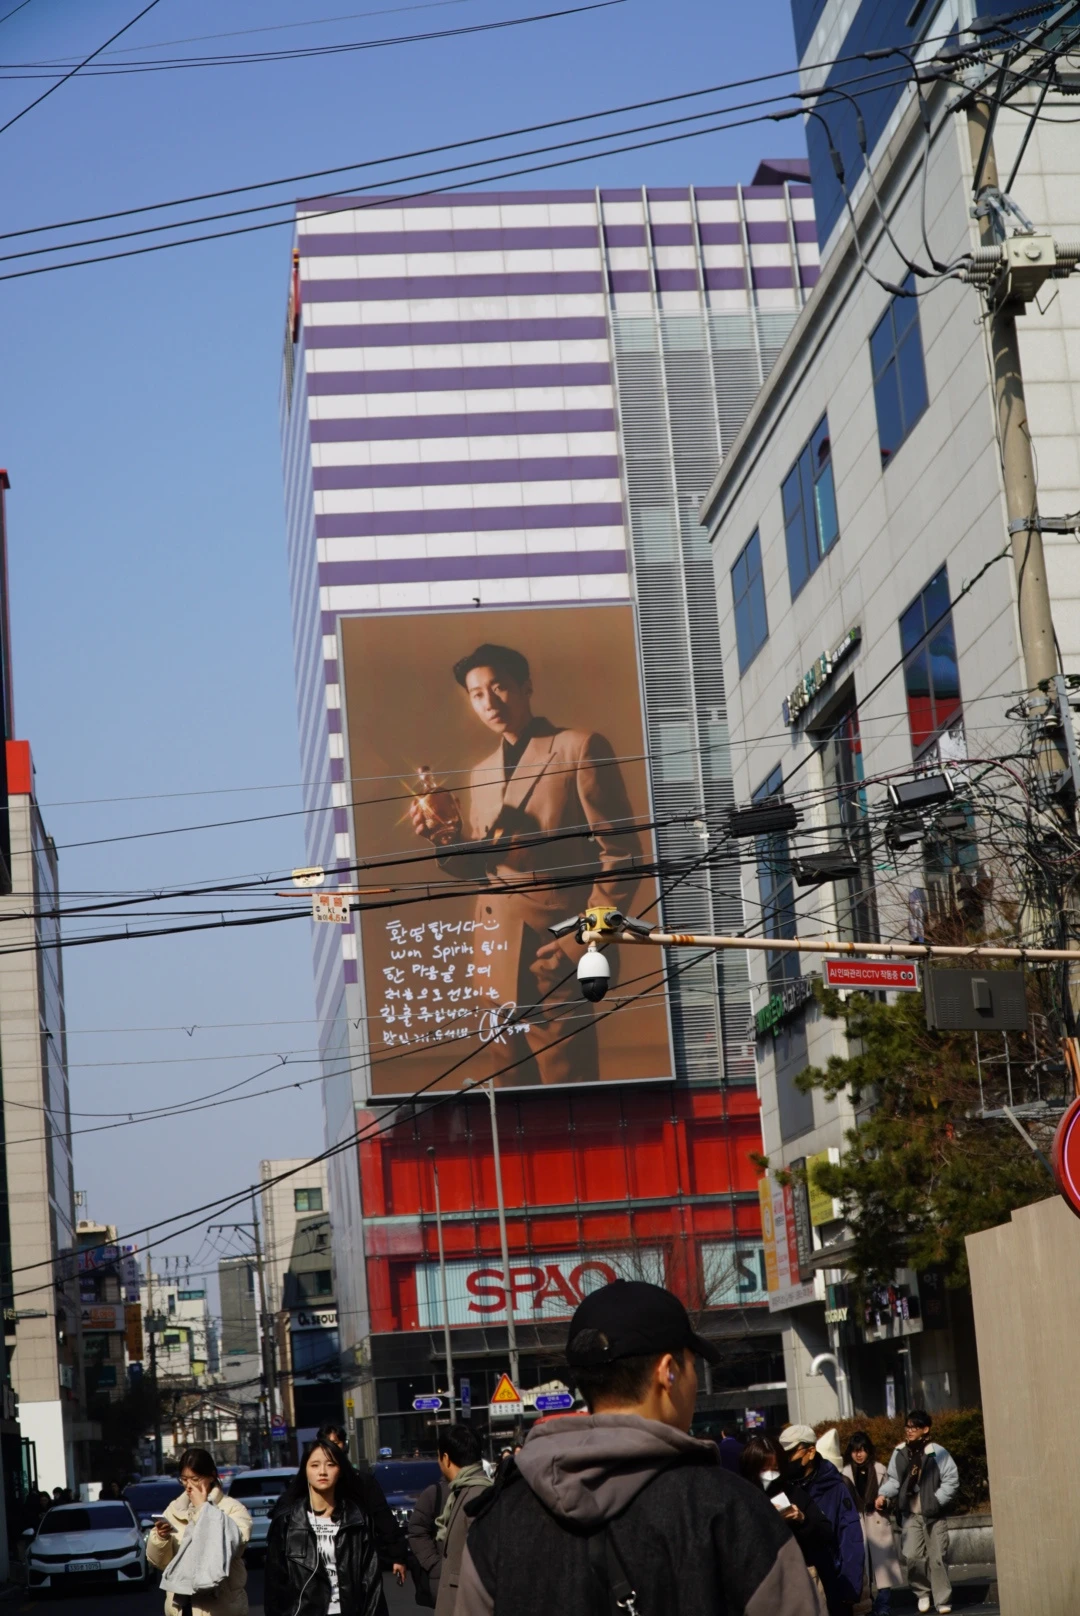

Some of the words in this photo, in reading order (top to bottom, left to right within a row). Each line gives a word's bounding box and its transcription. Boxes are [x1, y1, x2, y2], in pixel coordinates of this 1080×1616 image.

[385, 920, 483, 945] 환영합니다
[382, 966, 405, 984] 한
[412, 964, 456, 983] 마음을
[465, 963, 491, 978] 모여
[837, 968, 861, 979] 인파관리
[862, 970, 880, 979] CCTV
[880, 970, 898, 980] 작동중
[465, 1260, 618, 1314] SPAO
